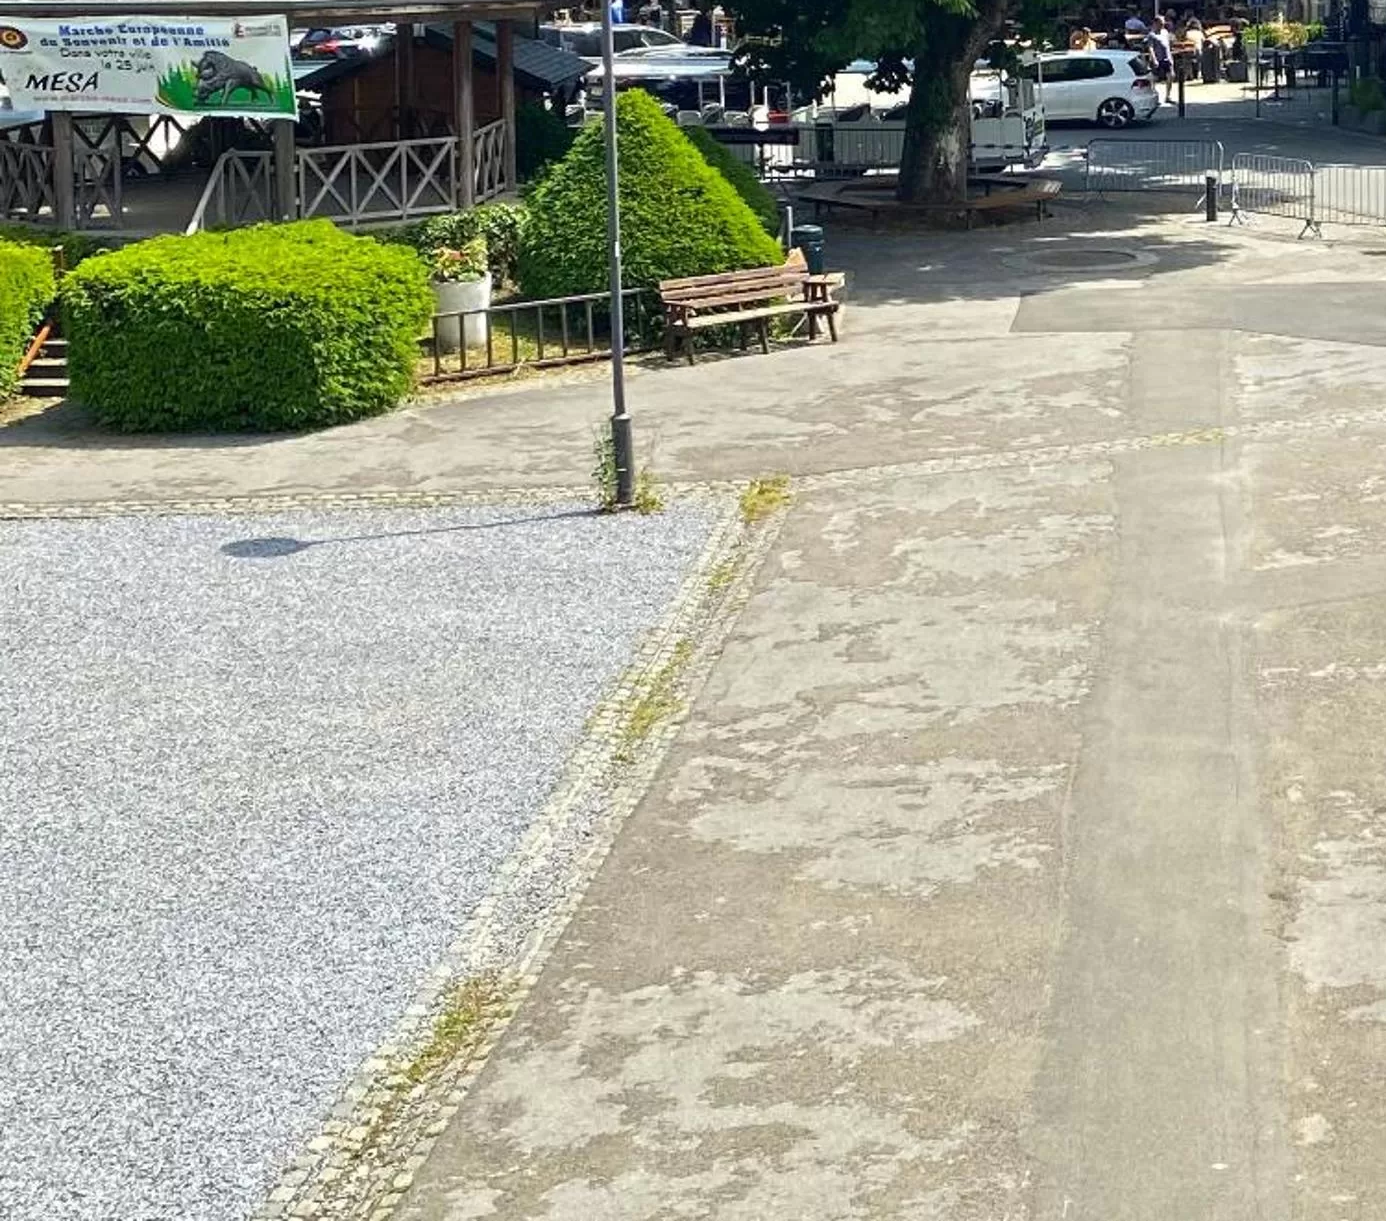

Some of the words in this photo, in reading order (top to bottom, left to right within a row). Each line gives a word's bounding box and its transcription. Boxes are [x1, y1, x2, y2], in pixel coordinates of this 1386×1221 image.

[40, 38, 58, 47] du
[151, 36, 168, 47] de
[25, 71, 99, 92] MESA
